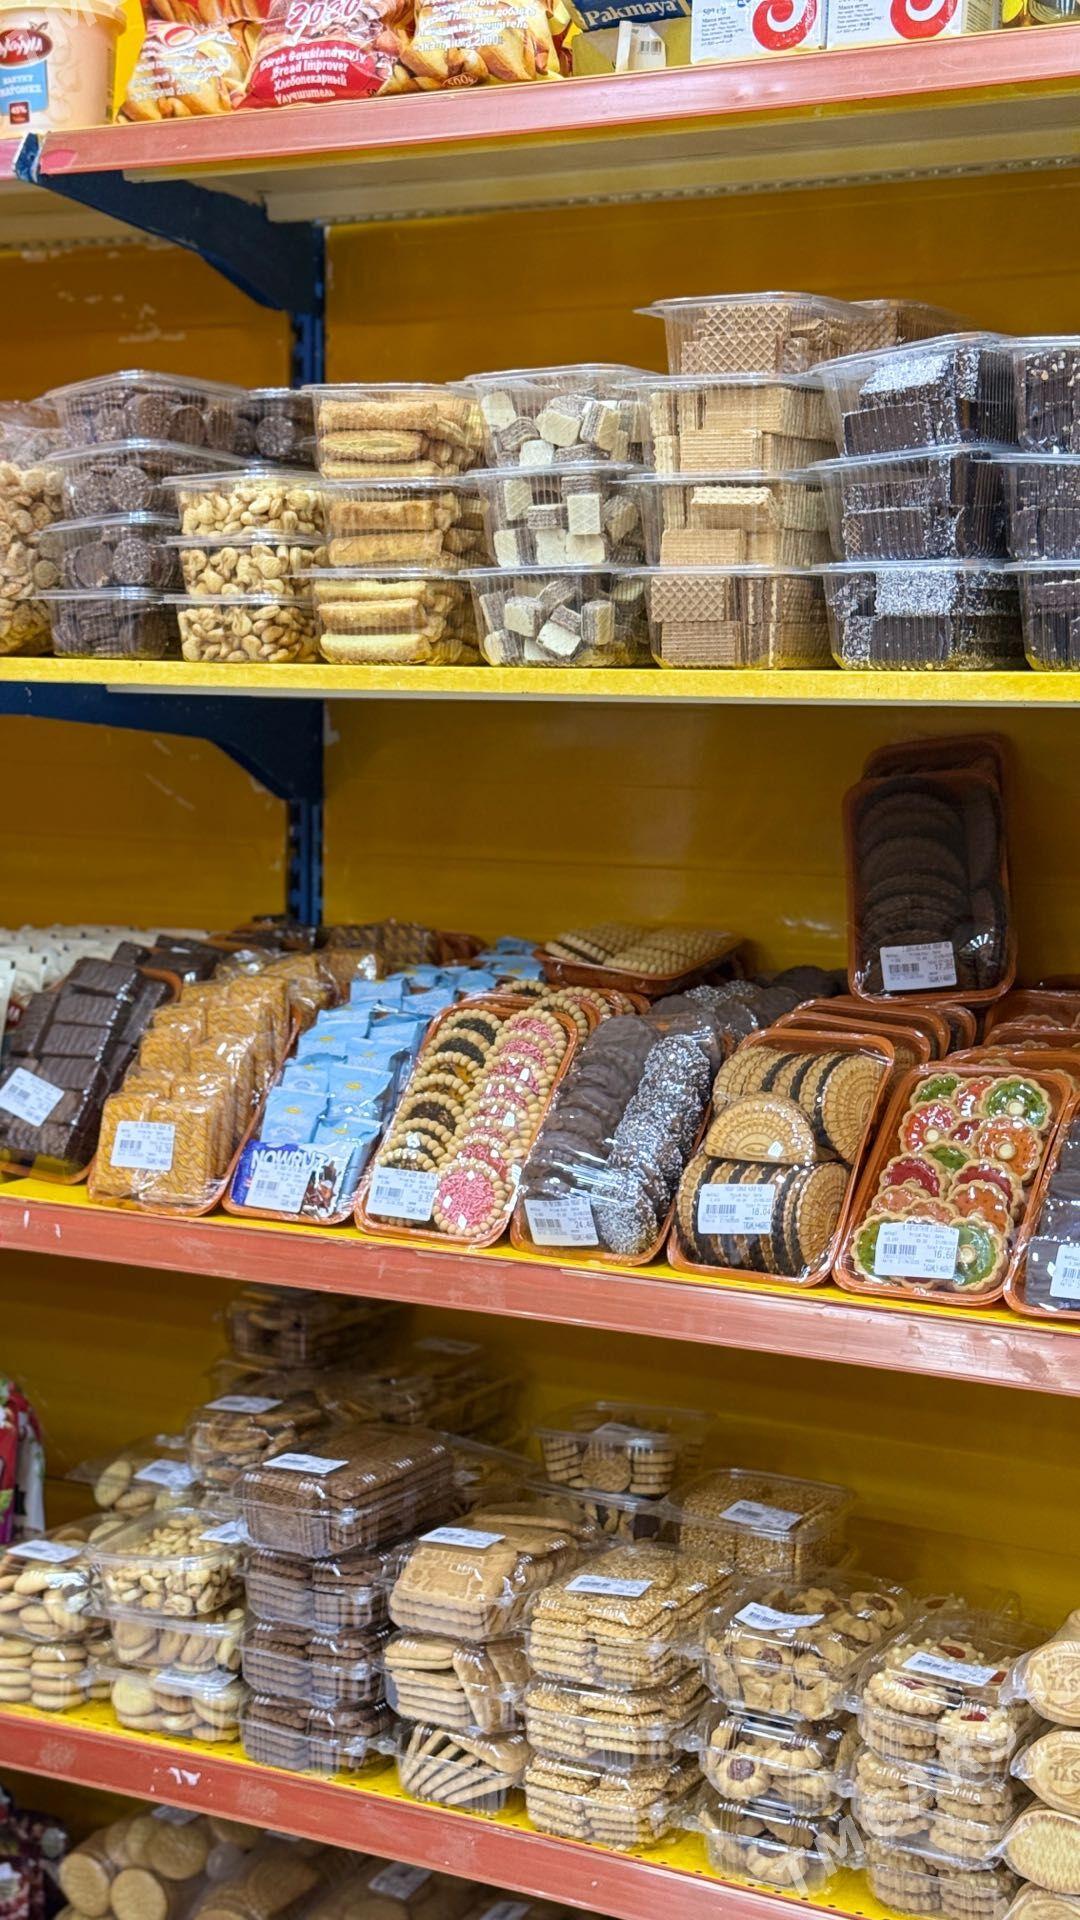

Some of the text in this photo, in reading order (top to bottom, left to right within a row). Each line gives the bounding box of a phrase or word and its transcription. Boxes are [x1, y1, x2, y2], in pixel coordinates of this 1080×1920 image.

[584, 0, 678, 27] Pakmaya
[272, 60, 349, 79] Bread Improver
[274, 74, 348, 92] Хлебопекарный
